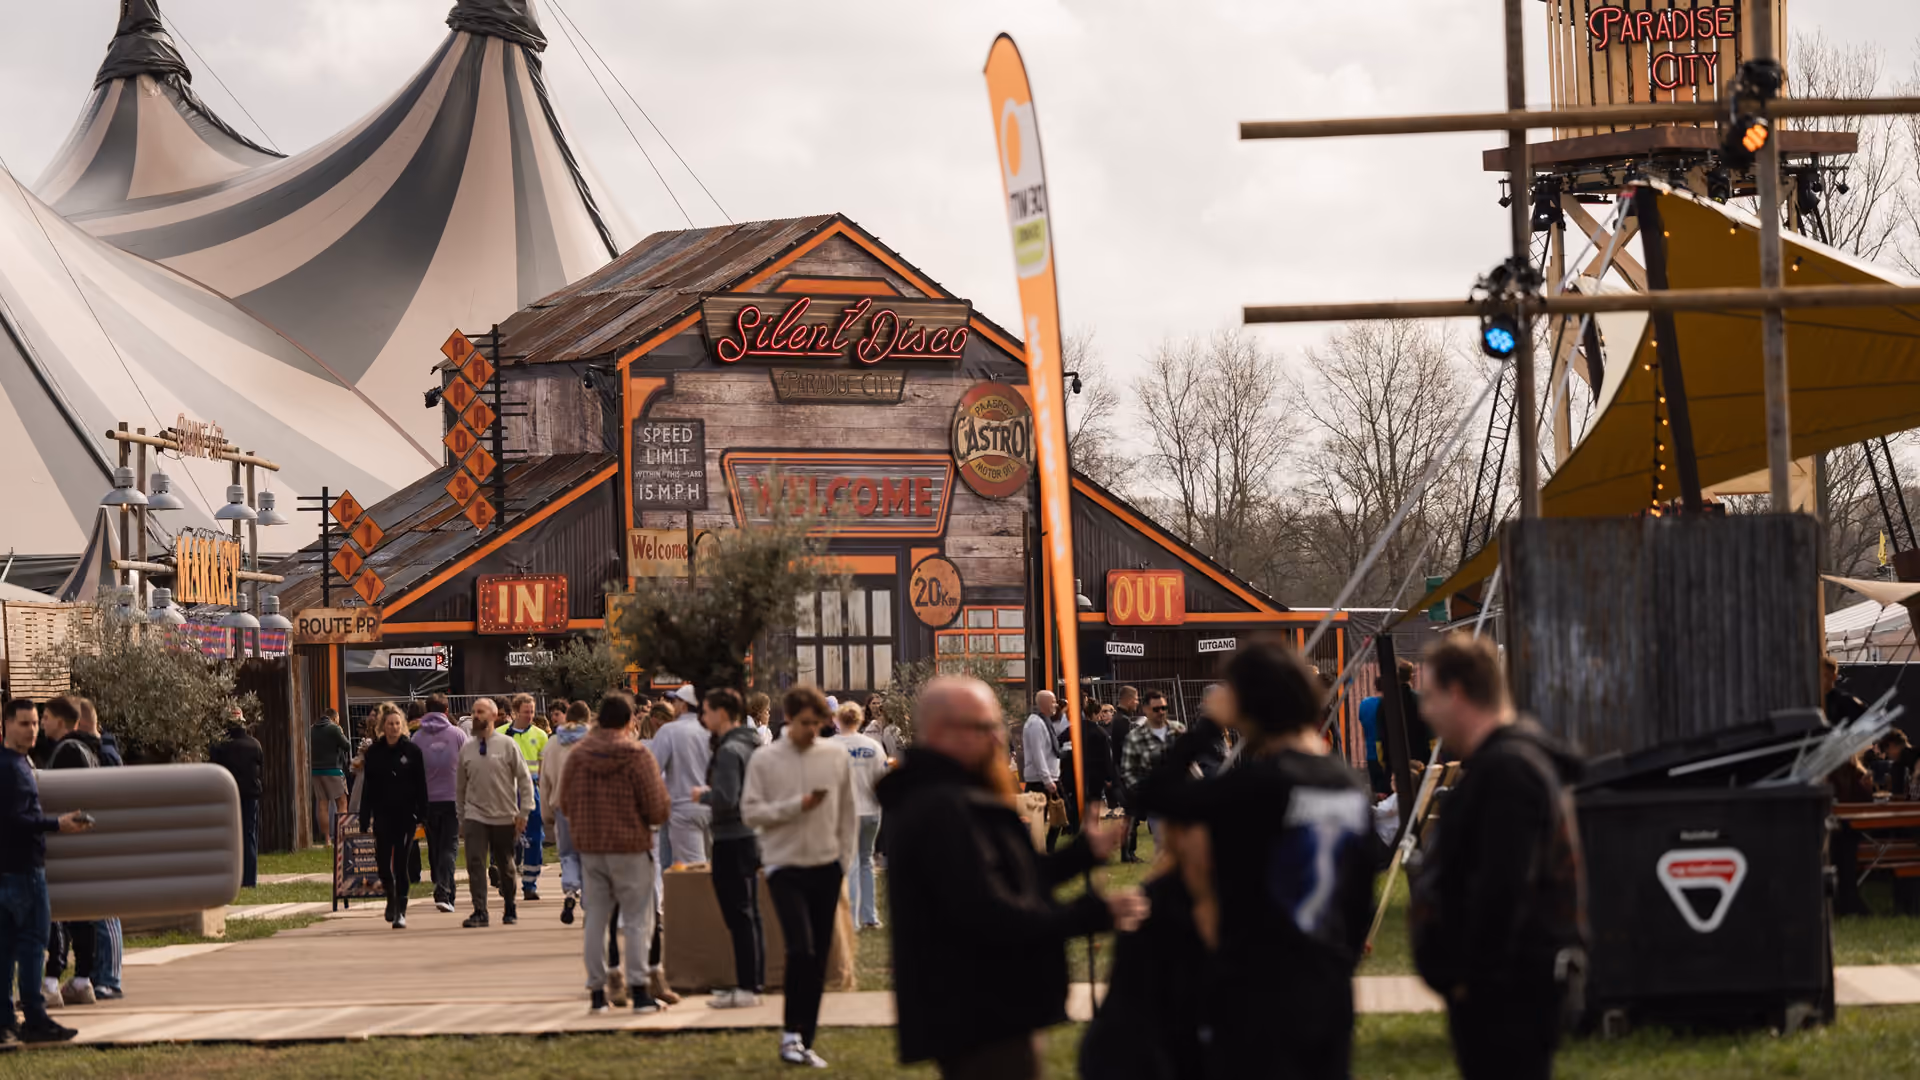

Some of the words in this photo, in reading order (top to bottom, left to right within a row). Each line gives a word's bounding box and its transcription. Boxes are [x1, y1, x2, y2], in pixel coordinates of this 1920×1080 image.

[1588, 6, 1734, 50] PARADISE
[1652, 52, 1718, 89] CITY
[717, 297, 872, 363] Silent
[857, 309, 969, 363] Disco
[643, 427, 693, 443] SPEED
[646, 448, 690, 465] LIMIT
[639, 484, 654, 501] 15
[631, 534, 688, 561] Welcome
[914, 576, 942, 607] 20
[1113, 576, 1177, 622] OUT
[498, 583, 545, 624] IN
[299, 617, 352, 635] ROUTE
[1107, 643, 1143, 655] UITGANG
[1200, 639, 1235, 651] UITGANG
[393, 657, 432, 668] INGANG
